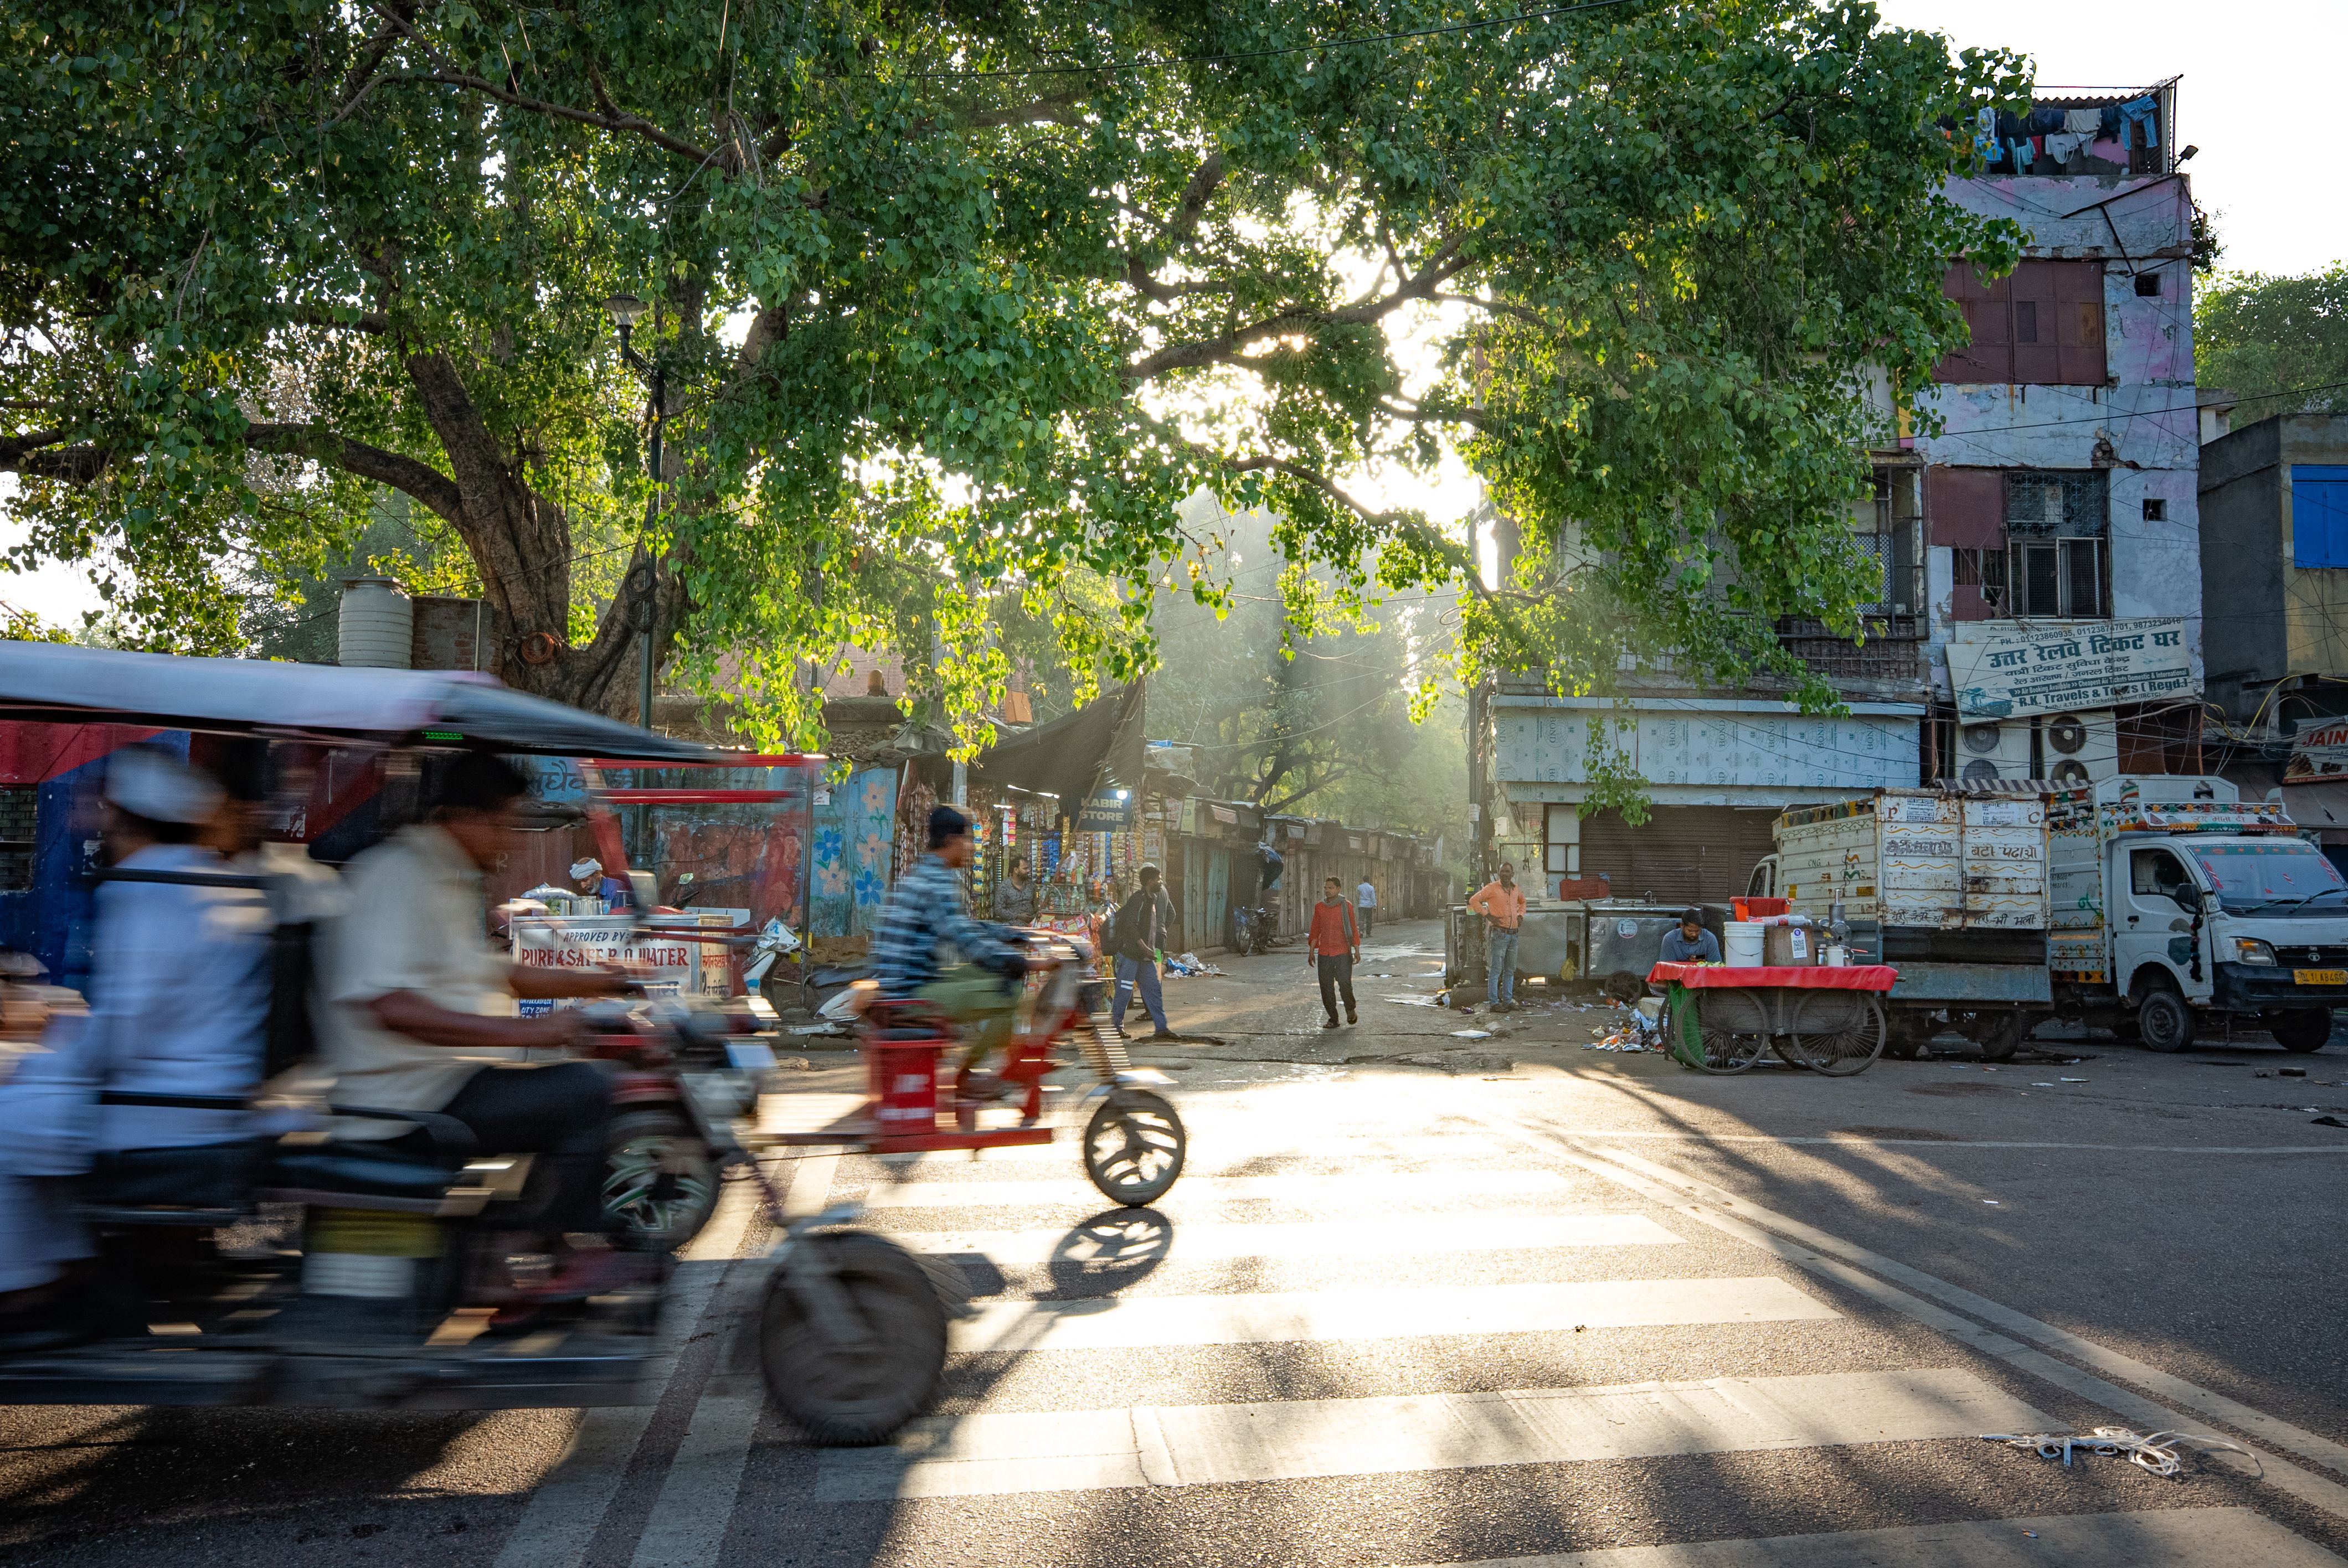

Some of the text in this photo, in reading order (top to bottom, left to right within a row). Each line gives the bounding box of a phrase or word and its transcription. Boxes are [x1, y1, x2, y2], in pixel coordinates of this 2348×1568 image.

[1985, 630, 2181, 668] उत्तर रेलवे टिकट घर
[2004, 666, 2030, 677] यात्री
[2033, 664, 2063, 674] टिकट
[2065, 658, 2100, 671] सुविधा
[2013, 677, 2028, 685] रेल
[2104, 665, 2129, 674] टिकट
[2019, 694, 2042, 707] R.K.
[2043, 689, 2089, 703] Travels
[2092, 689, 2101, 698] &
[2302, 730, 2348, 746] JAIN
[1080, 797, 1123, 809] KABIR
[1079, 810, 1124, 822] STORE
[1808, 858, 1822, 867] CNG
[563, 931, 609, 942] APPROVED
[611, 931, 630, 942] BY:
[521, 948, 555, 967] PURE
[556, 950, 565, 965] &
[639, 947, 689, 967] WATER
